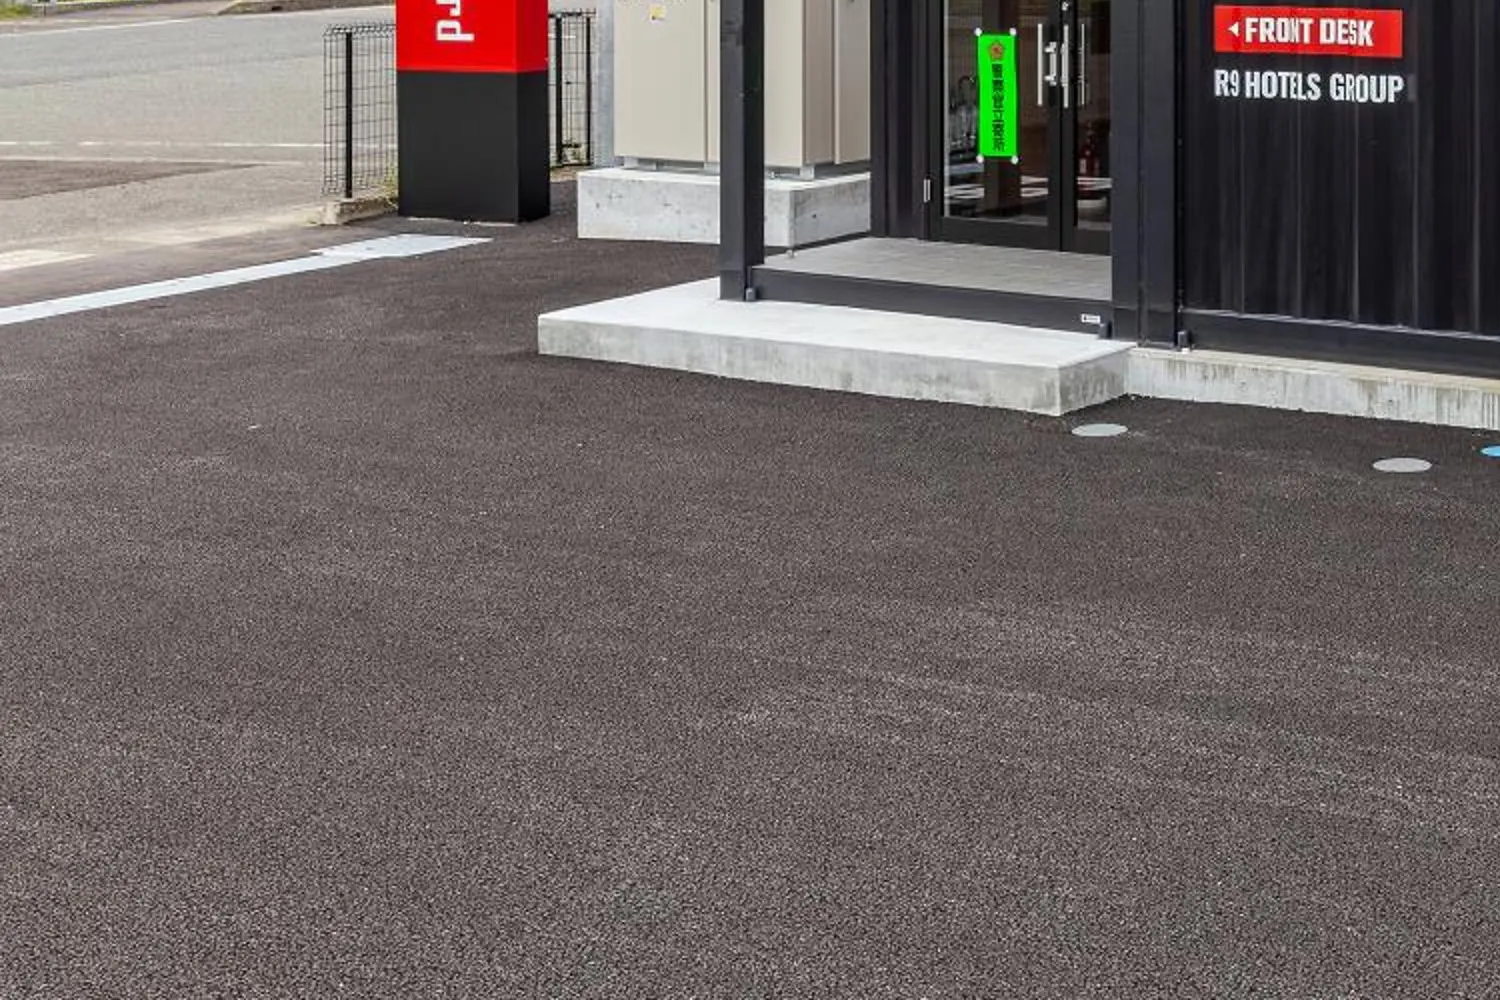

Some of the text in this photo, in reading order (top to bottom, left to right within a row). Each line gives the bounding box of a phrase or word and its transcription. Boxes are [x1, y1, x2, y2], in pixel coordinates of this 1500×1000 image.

[1244, 17, 1375, 47] FRONT DESK
[1214, 69, 1405, 103] R9 HOTELS GROUP
